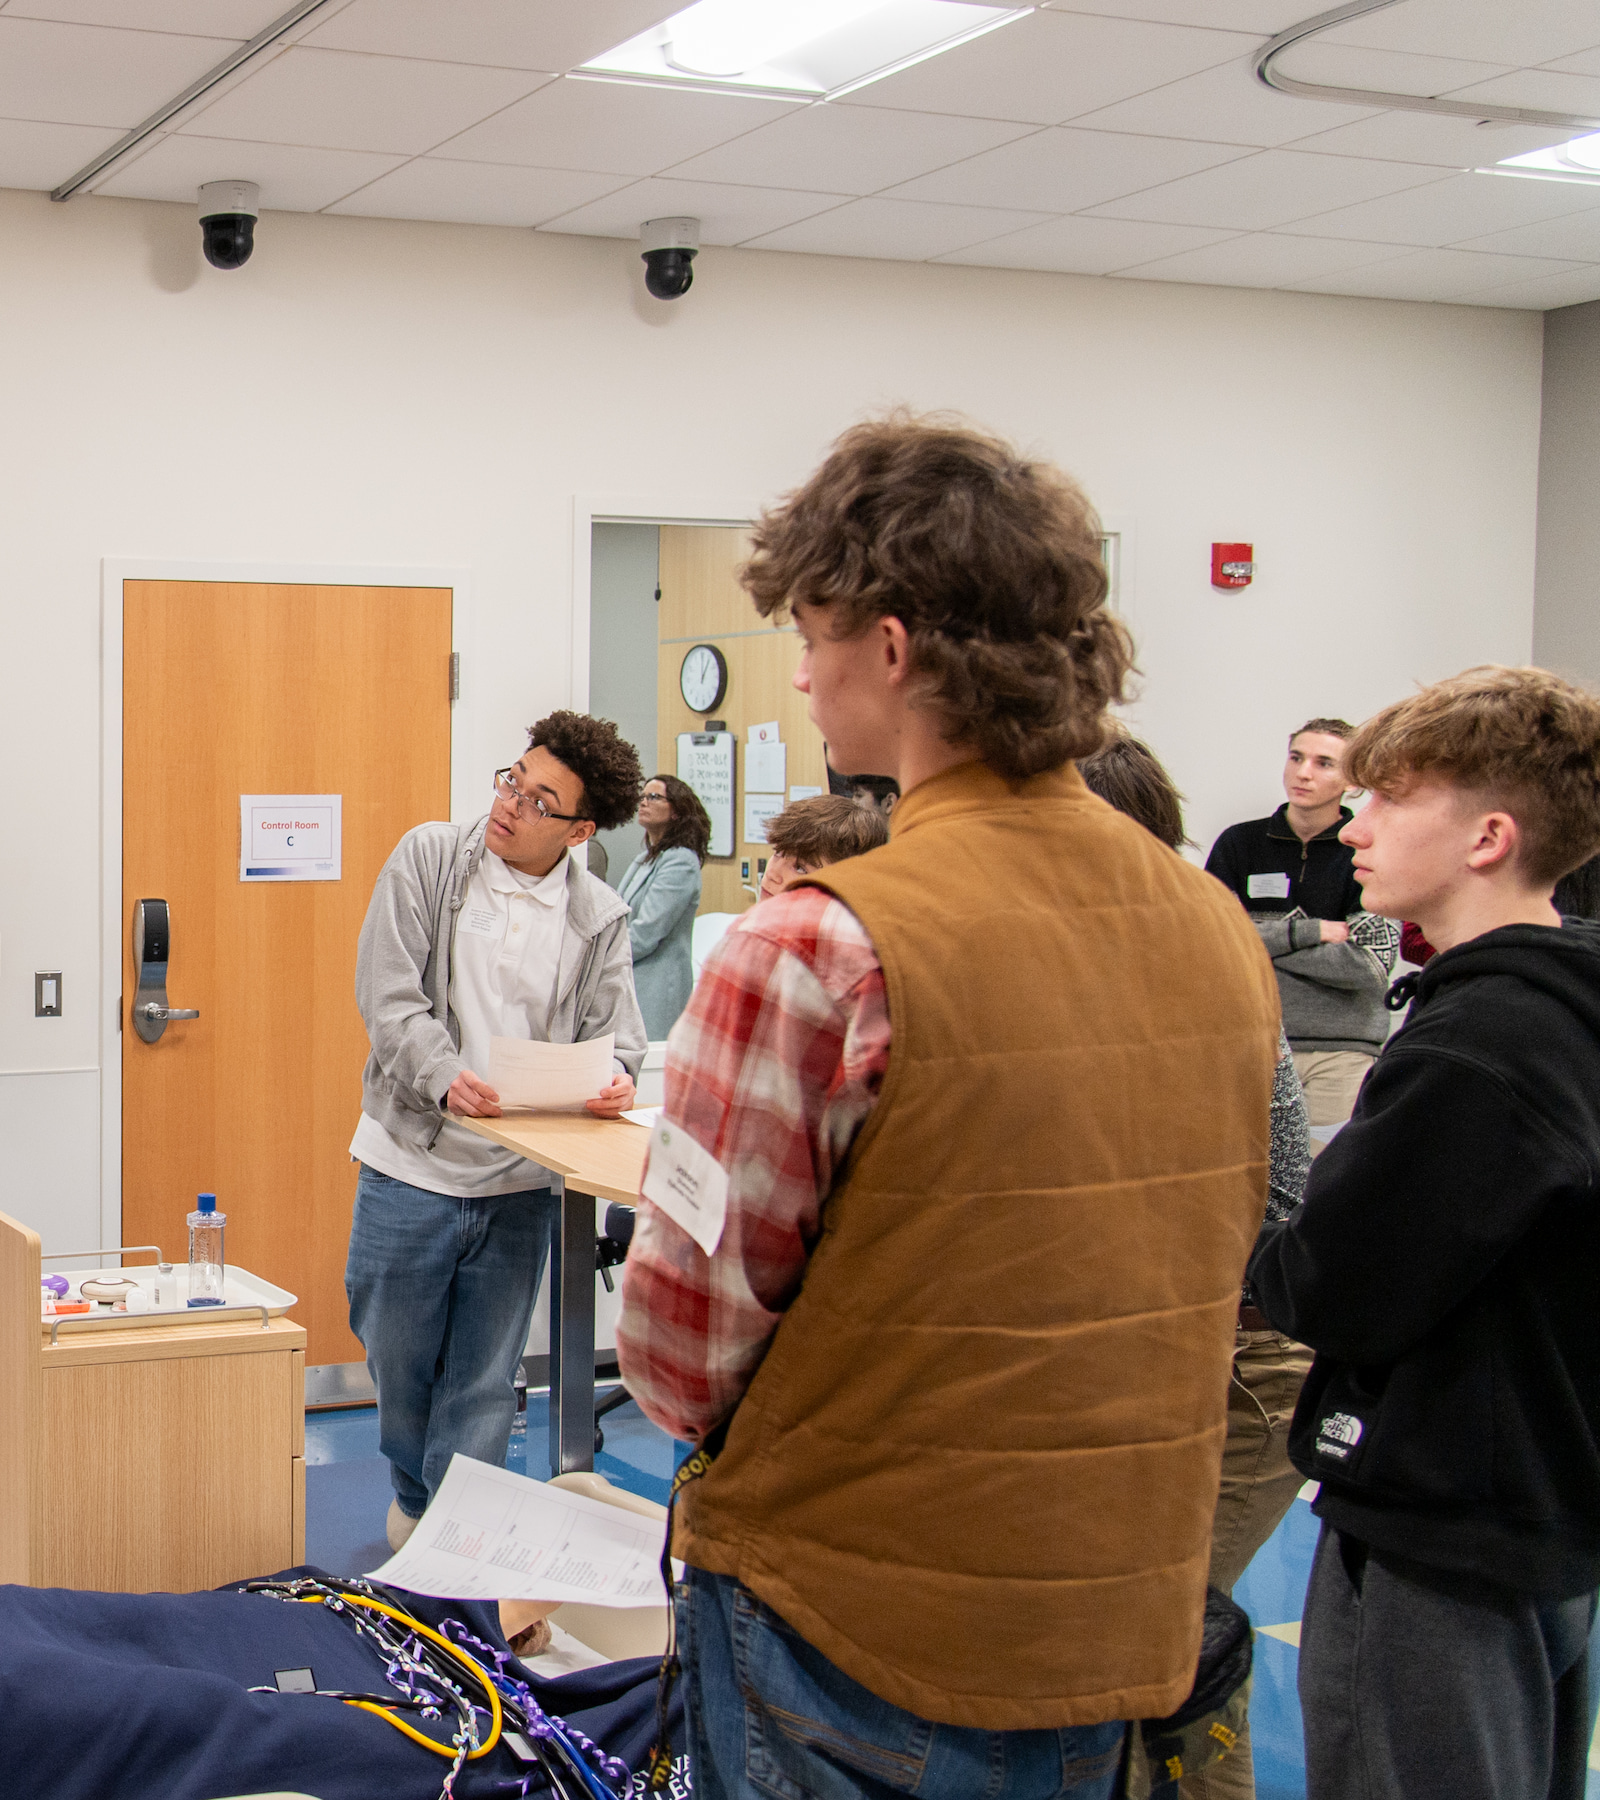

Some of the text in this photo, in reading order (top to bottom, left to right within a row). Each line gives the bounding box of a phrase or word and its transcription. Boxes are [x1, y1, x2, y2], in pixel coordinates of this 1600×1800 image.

[261, 820, 319, 830] Control Room
[286, 835, 294, 847] C
[1333, 1411, 1351, 1424] THE
